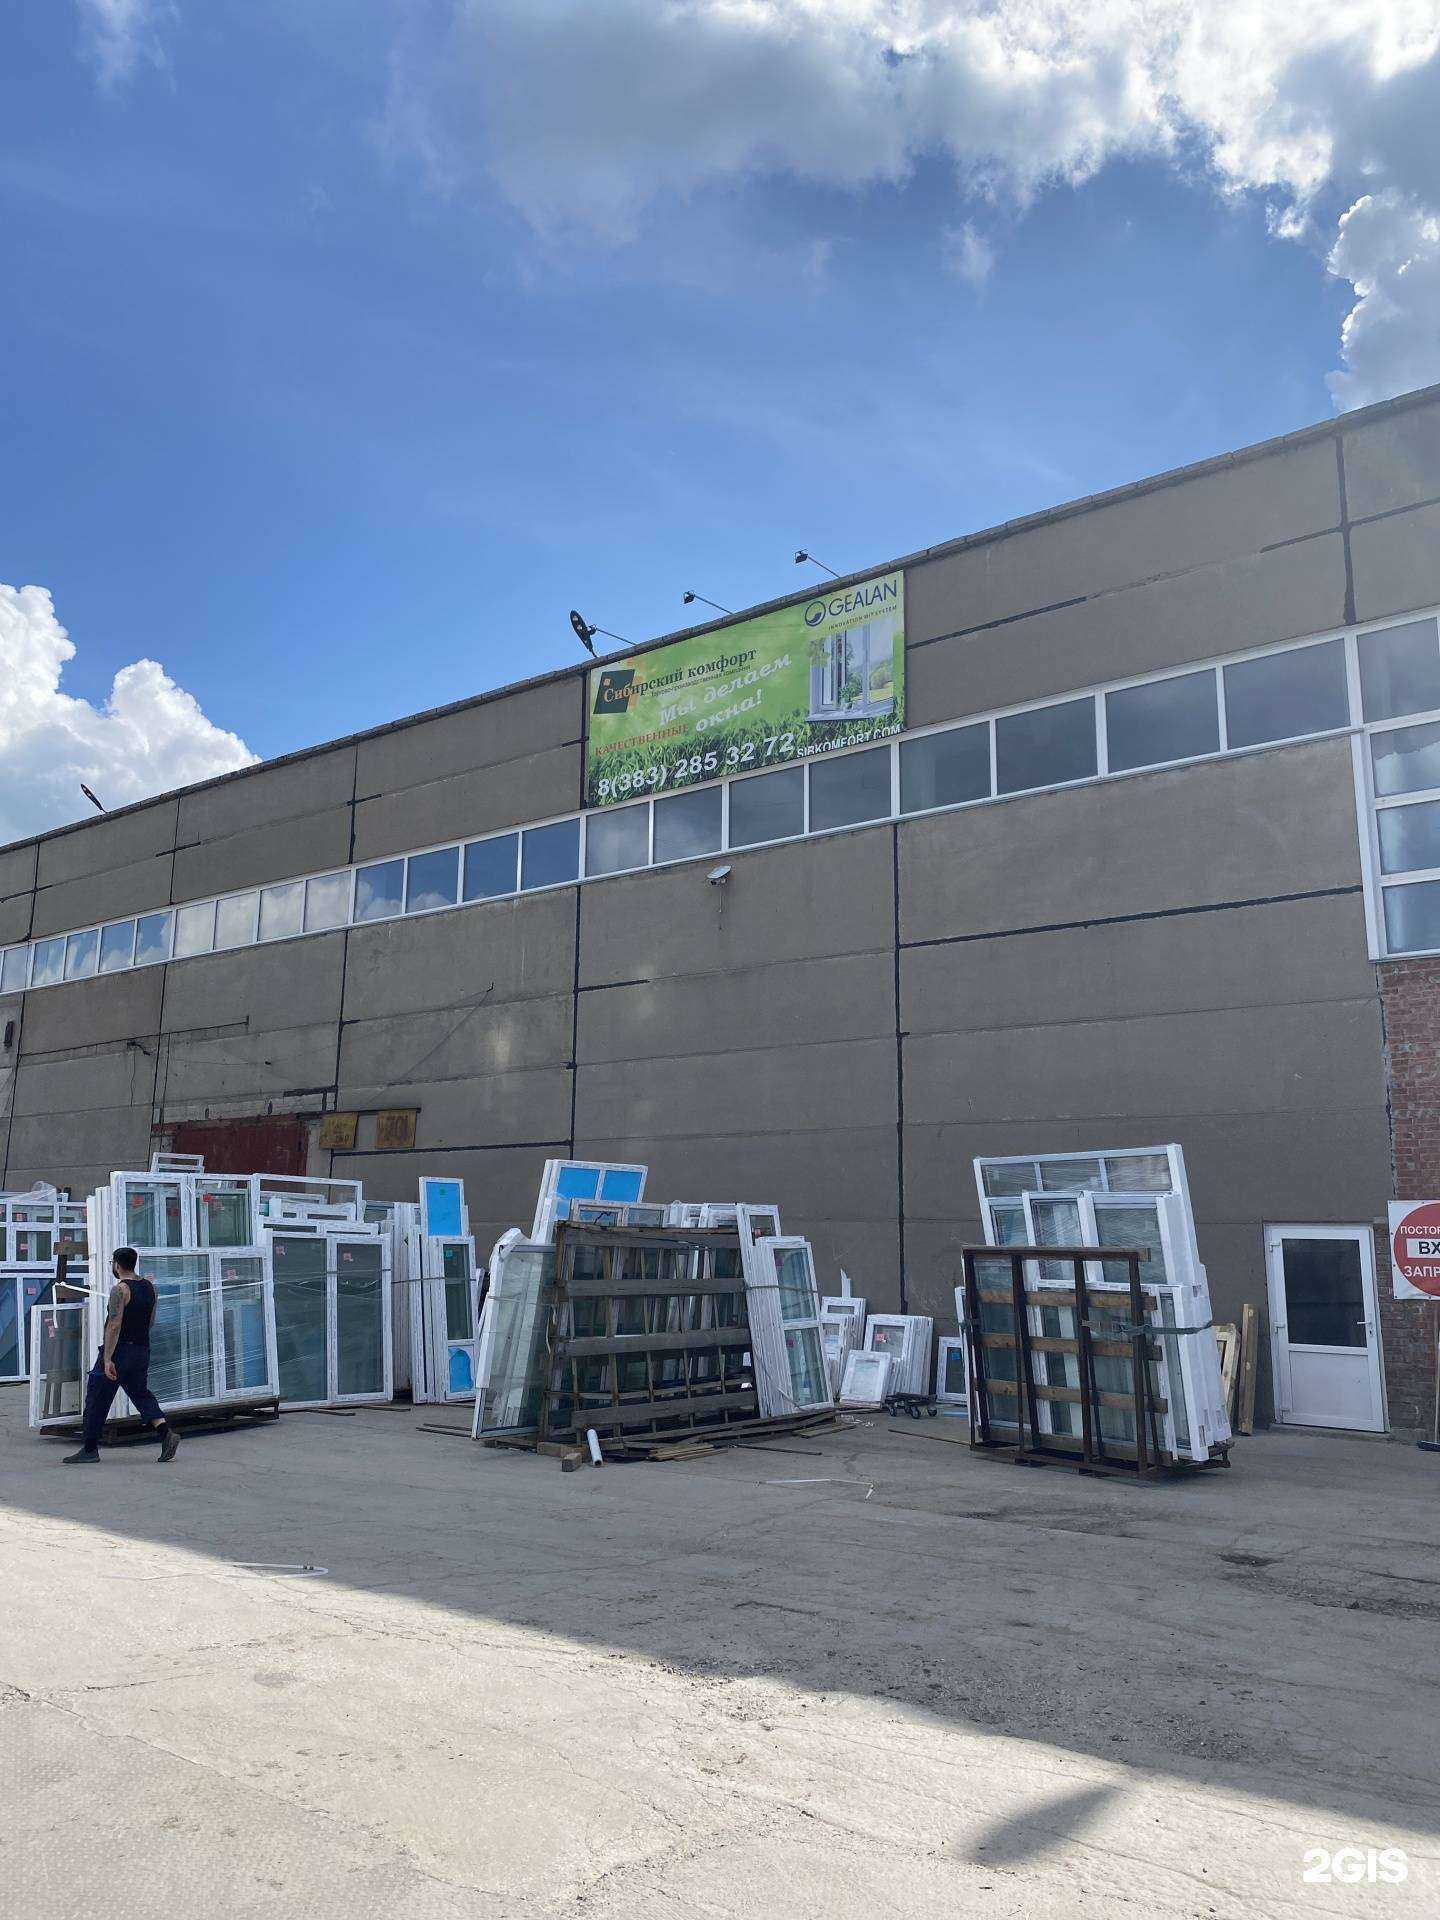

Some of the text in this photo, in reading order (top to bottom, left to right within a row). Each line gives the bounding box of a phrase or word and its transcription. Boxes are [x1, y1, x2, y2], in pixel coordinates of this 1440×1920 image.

[829, 580, 897, 616] GEALAN
[603, 667, 683, 703] Сибирский
[687, 649, 758, 679] комфорт
[704, 654, 792, 703] делаем
[597, 731, 795, 798] 8(383) 285 32 72
[1400, 1225, 1440, 1235] ПОСТО
